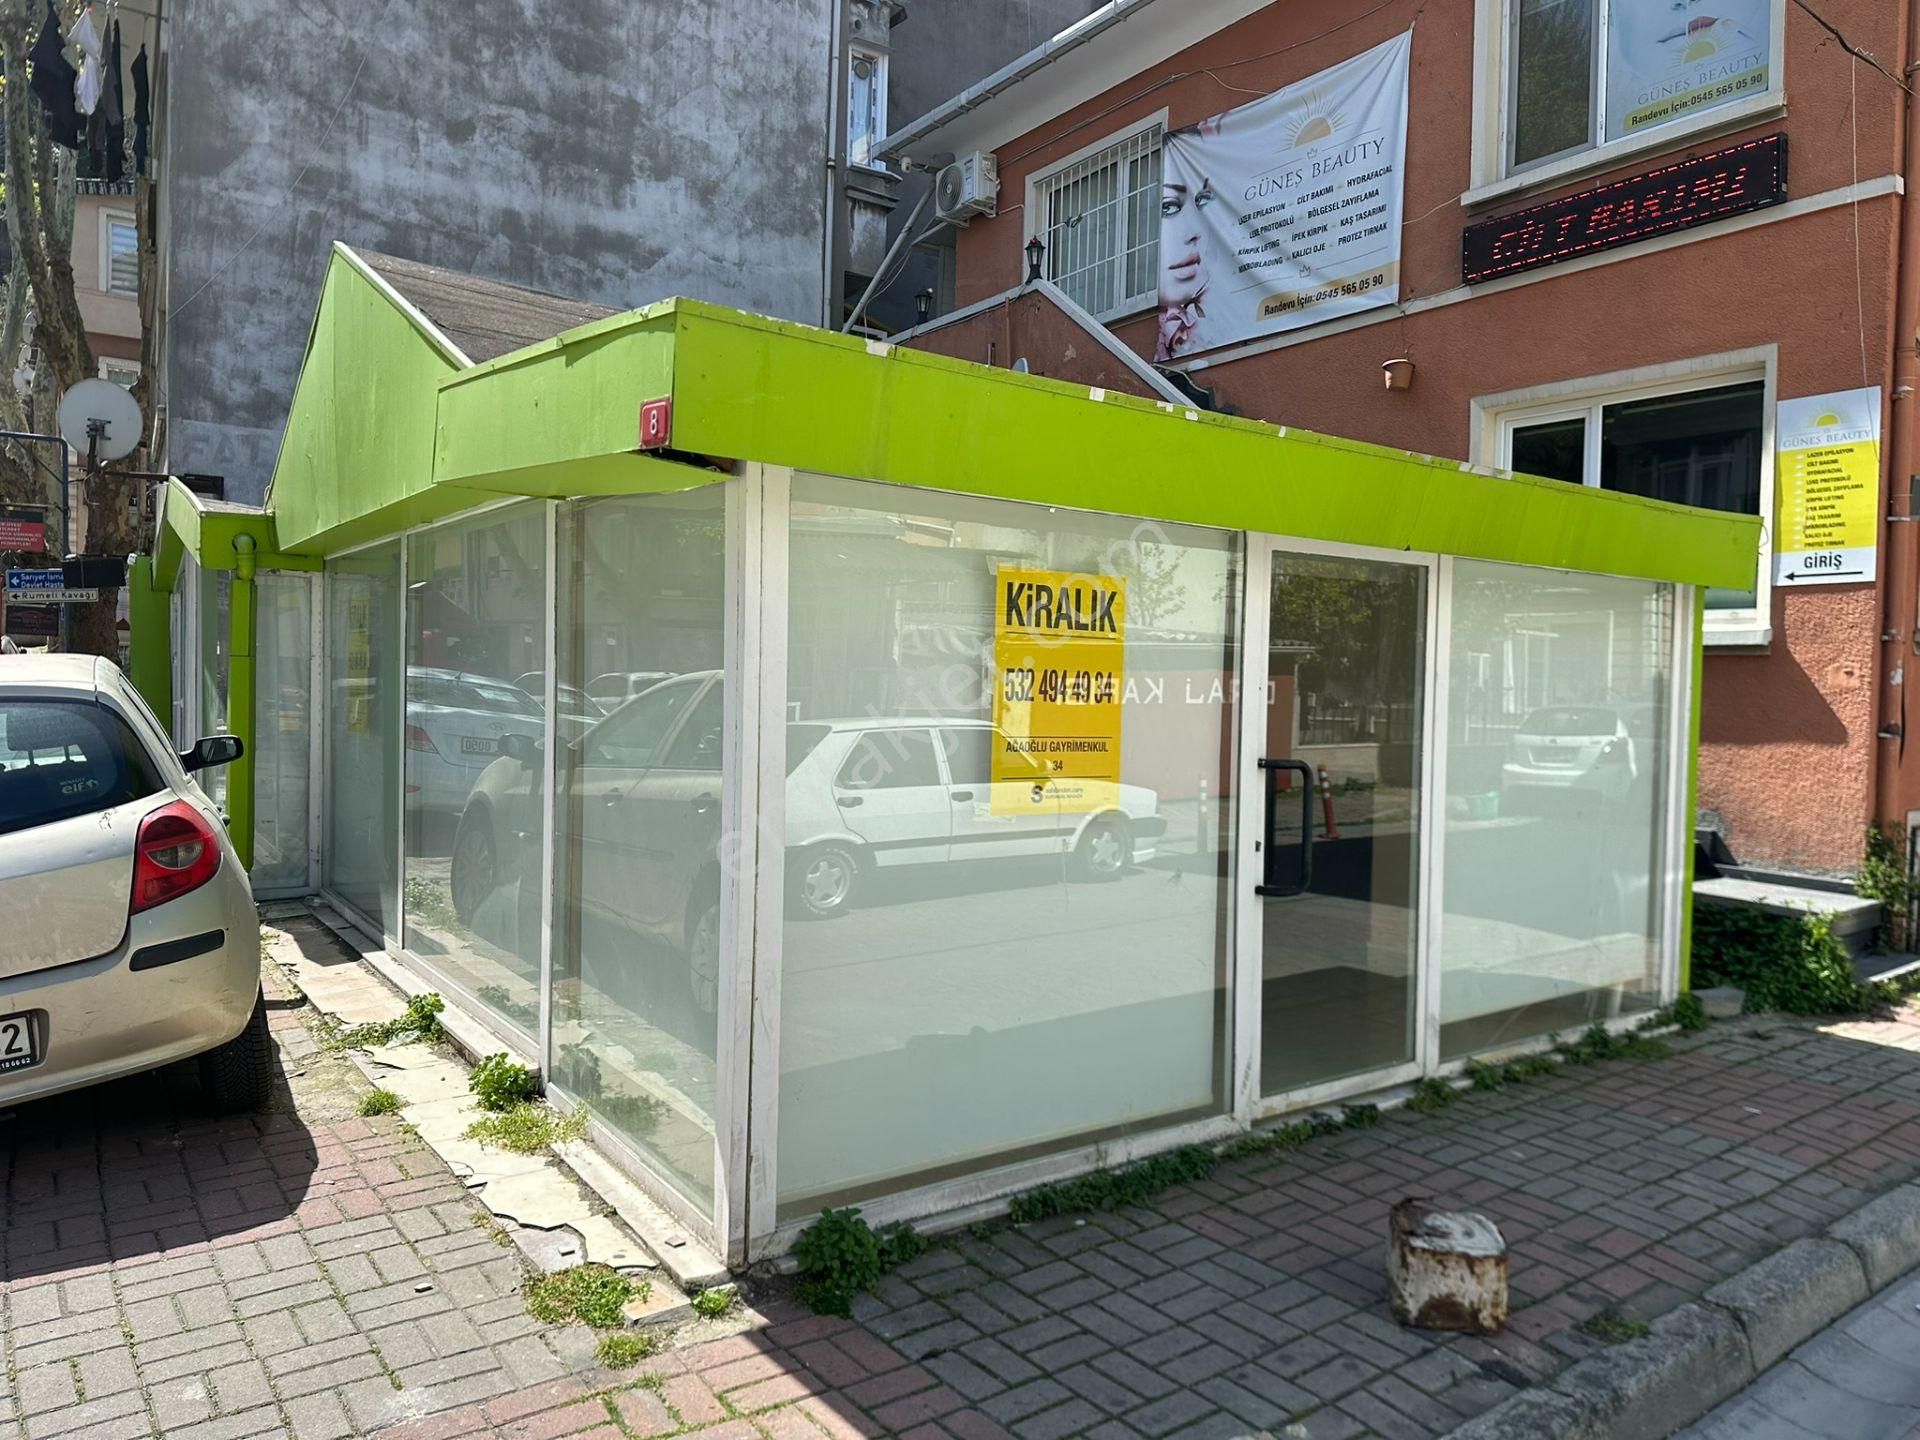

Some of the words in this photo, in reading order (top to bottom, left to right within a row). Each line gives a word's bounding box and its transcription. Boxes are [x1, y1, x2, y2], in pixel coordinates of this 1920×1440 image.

[1698, 52, 1763, 84] BEAUTY
[1631, 108, 1669, 126] Randevu
[1716, 83, 1733, 97] 565
[1736, 79, 1747, 90] 05
[1750, 73, 1763, 86] 90
[1243, 168, 1304, 202] GÜNEŞ
[1312, 137, 1386, 178] BEAUTY
[1346, 164, 1393, 188] HYDRAFACIAL
[1307, 202, 1341, 219] BÖLGESEL
[1341, 188, 1380, 209] ZAYIFLAMA
[1340, 214, 1355, 231] KAŞ
[1313, 242, 1327, 253] OJE
[1337, 230, 1361, 247] PROTEZ
[1361, 220, 1389, 239] TIRNAK
[1263, 299, 1296, 317] Randevu
[1341, 282, 1357, 296] 565
[1358, 278, 1370, 291] 05
[1372, 273, 1384, 287] 90
[649, 409, 659, 435] 8
[1826, 429, 1872, 444] BEAUTY
[1804, 552, 1843, 571] GİRİŞ
[21, 590, 58, 600] Rumeli
[1004, 667, 1035, 703] 532
[1038, 668, 1068, 703] 494
[1071, 670, 1091, 704] 49
[1094, 671, 1113, 704] 34
[1005, 739, 1048, 754] AĞAOĞLU
[1049, 739, 1109, 754] GAYRİMENKUL
[1052, 760, 1063, 771] 34
